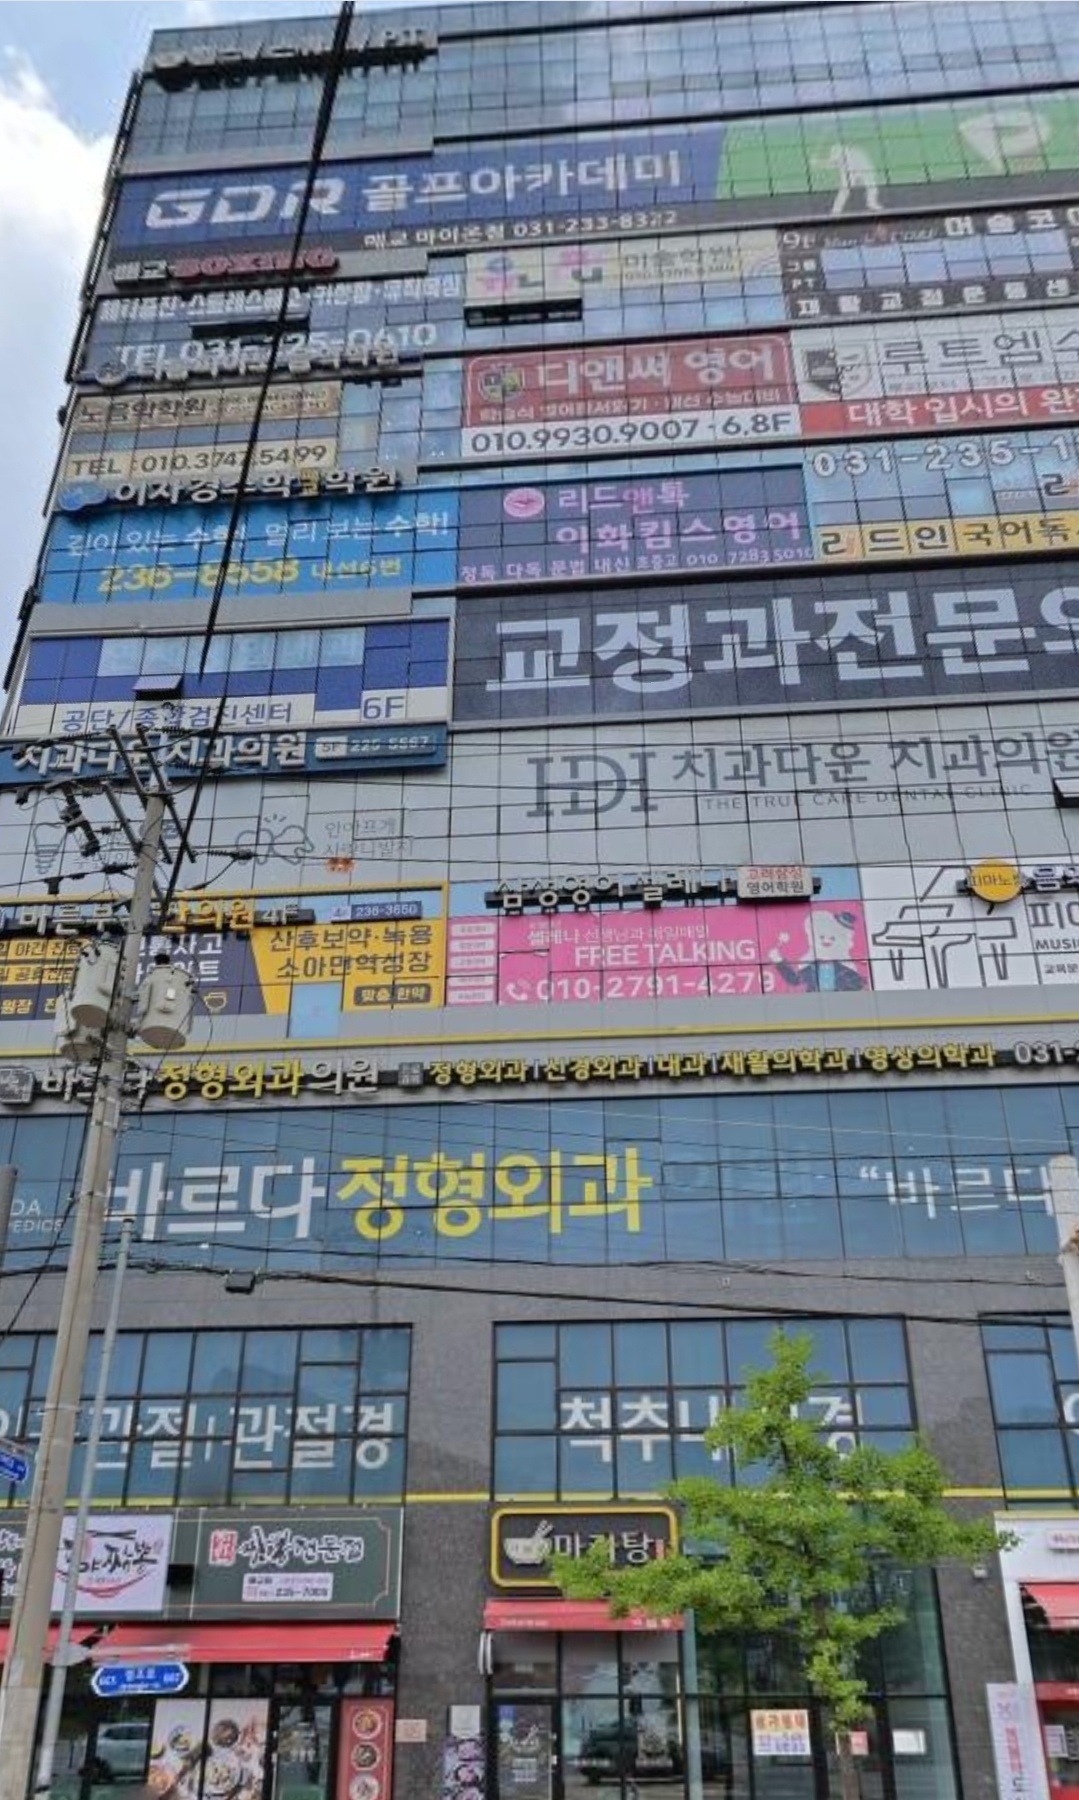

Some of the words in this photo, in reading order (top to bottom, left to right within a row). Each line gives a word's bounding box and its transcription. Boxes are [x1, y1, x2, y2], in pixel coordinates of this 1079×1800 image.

[144, 177, 346, 229] GDR
[363, 150, 680, 213] 골프아카데미
[683, 344, 777, 386] 영어
[471, 418, 698, 453] 010.9930.9007
[73, 457, 122, 476] TEL
[386, 509, 450, 538] 수학!
[550, 559, 586, 577] 문법
[686, 553, 719, 566] 010
[362, 696, 405, 721] 6F
[671, 743, 873, 790] 치과다운
[705, 798, 741, 811] THE
[746, 880, 805, 896] 영어학원
[574, 944, 640, 969] FREE
[643, 940, 757, 966] TALKING
[1035, 938, 1079, 952] MUSI
[277, 951, 432, 979] 소아면역성장
[536, 971, 776, 1000] 010-2791-4279
[429, 1060, 527, 1087] 정형외과
[544, 1054, 642, 1083] 신경외과
[656, 1052, 707, 1078] 내과
[863, 1040, 997, 1071] 영상의학과
[10, 1199, 42, 1216] DA
